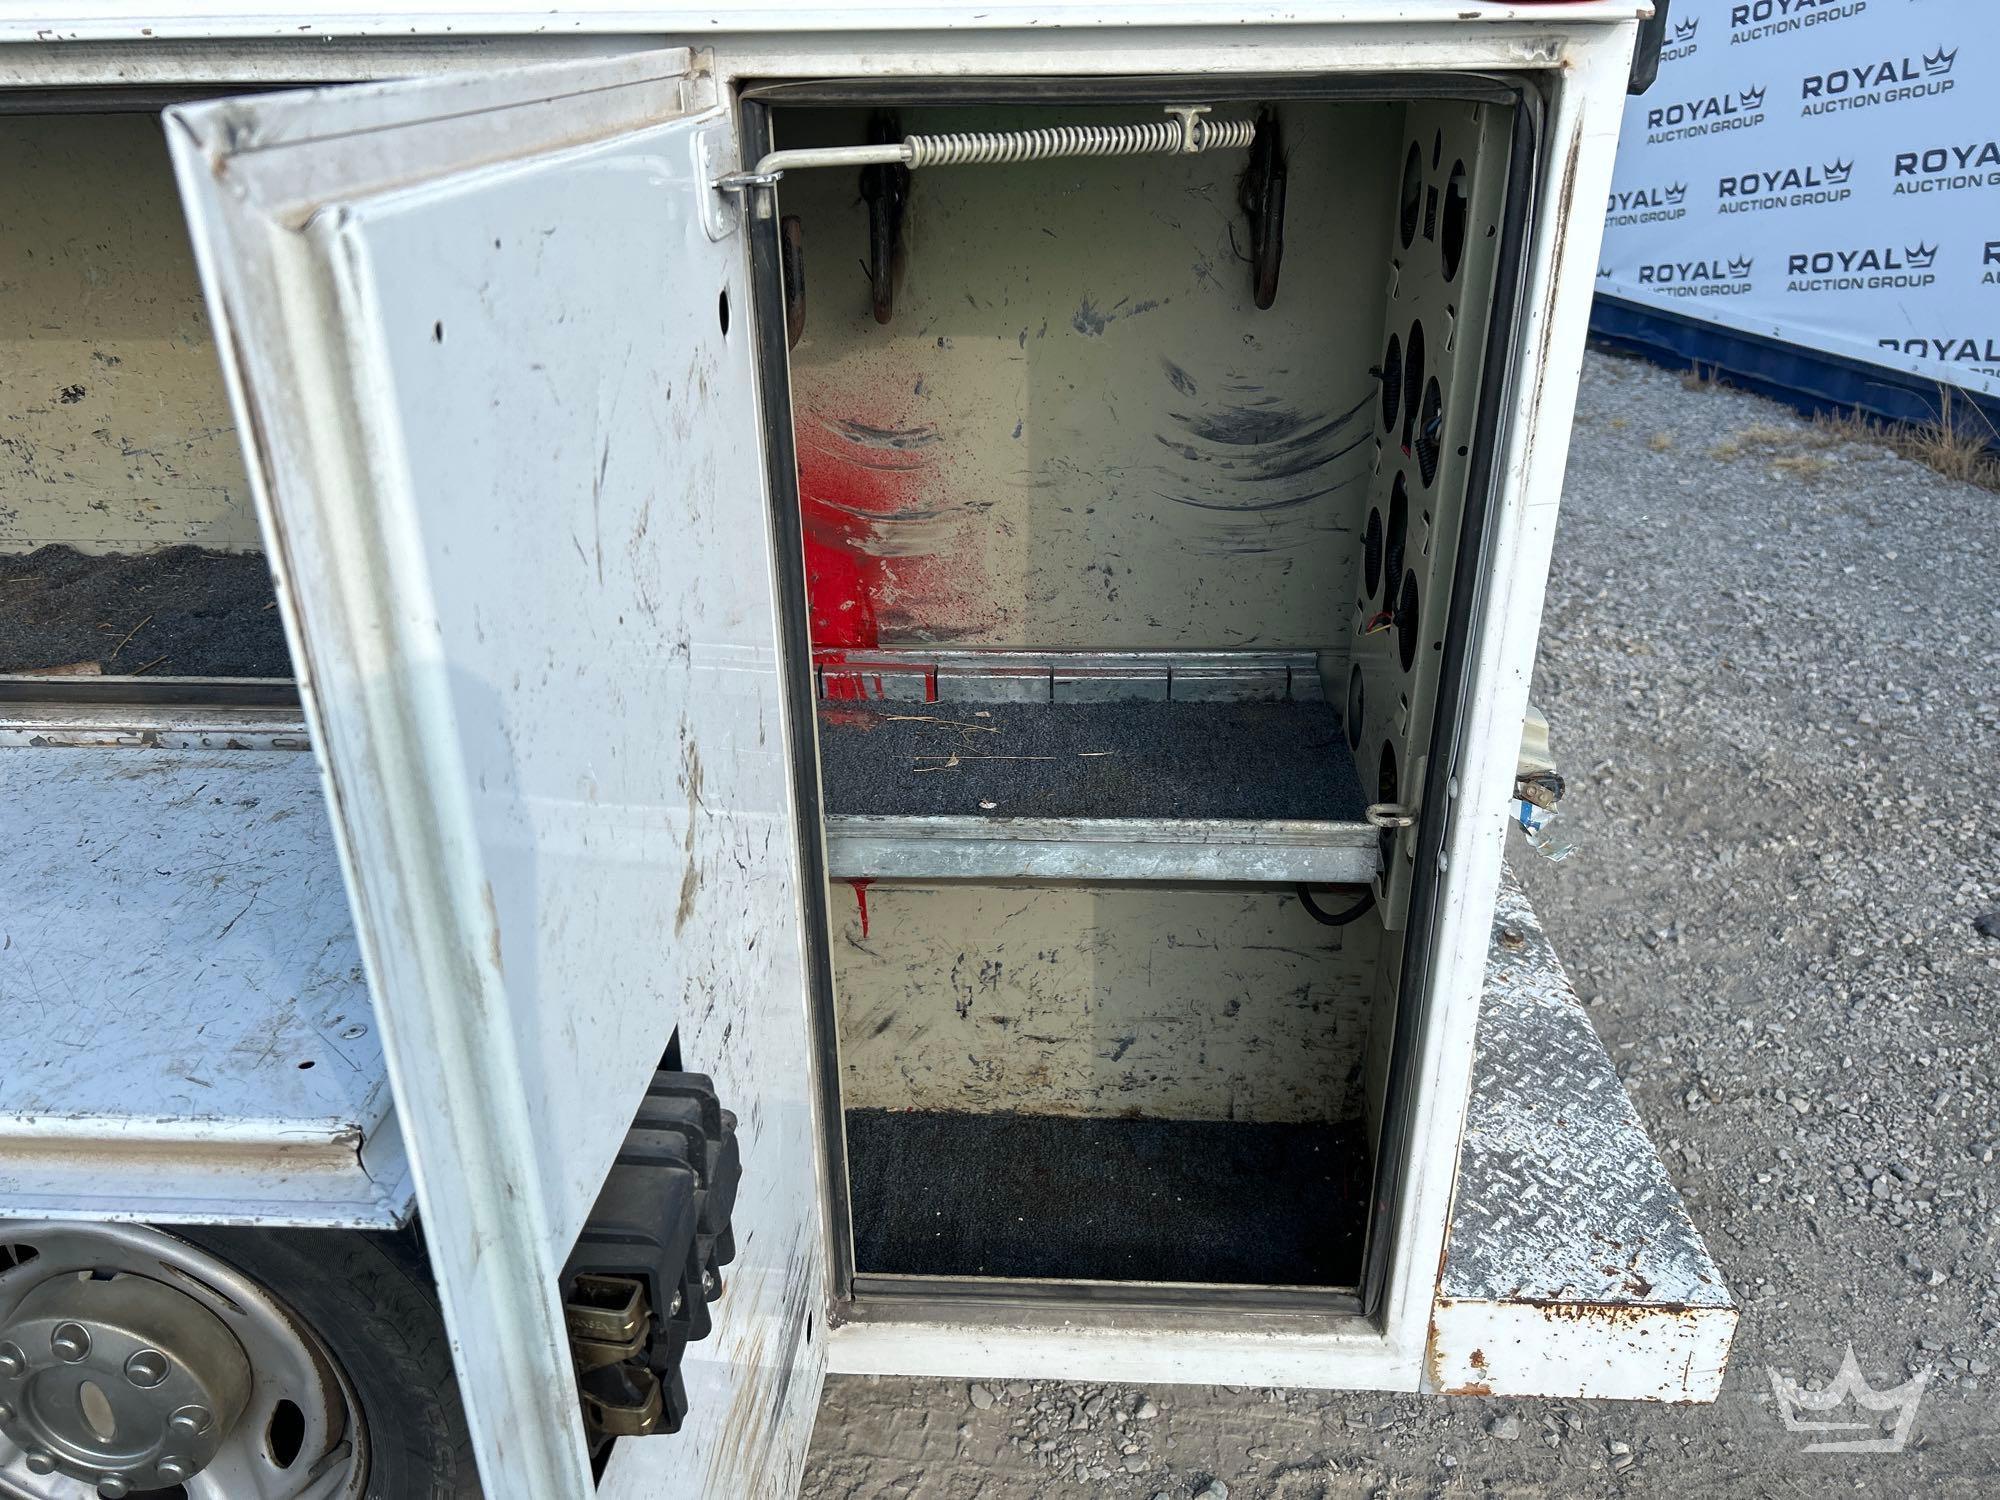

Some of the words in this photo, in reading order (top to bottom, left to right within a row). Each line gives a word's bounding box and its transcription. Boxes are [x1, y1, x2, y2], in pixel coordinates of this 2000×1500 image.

[1730, 18, 1801, 45] AUCTION
[1804, 1, 1867, 27] GROUP
[1660, 44, 1697, 62] ROUP
[1802, 58, 1920, 99] ROYAL
[1648, 94, 1737, 129] ROYAL
[1801, 91, 1881, 117] AUCTION
[1885, 79, 1955, 103] GROUP
[1647, 124, 1708, 145] AUCTION
[1711, 113, 1764, 133] GROUP
[1894, 142, 2000, 177] ROYA
[1719, 166, 1821, 198] ROYAL
[1893, 174, 1983, 195] AUCTION
[1718, 196, 1787, 214] AUCTION
[1790, 188, 1851, 206] GROUP
[1640, 208, 1686, 224] GROUP
[1639, 260, 1726, 284] ROYAL
[1788, 248, 1902, 275] ROYAL
[1700, 283, 1752, 297] GROUP
[1787, 277, 1864, 292] AUCTION
[1868, 274, 1935, 289] GROUP
